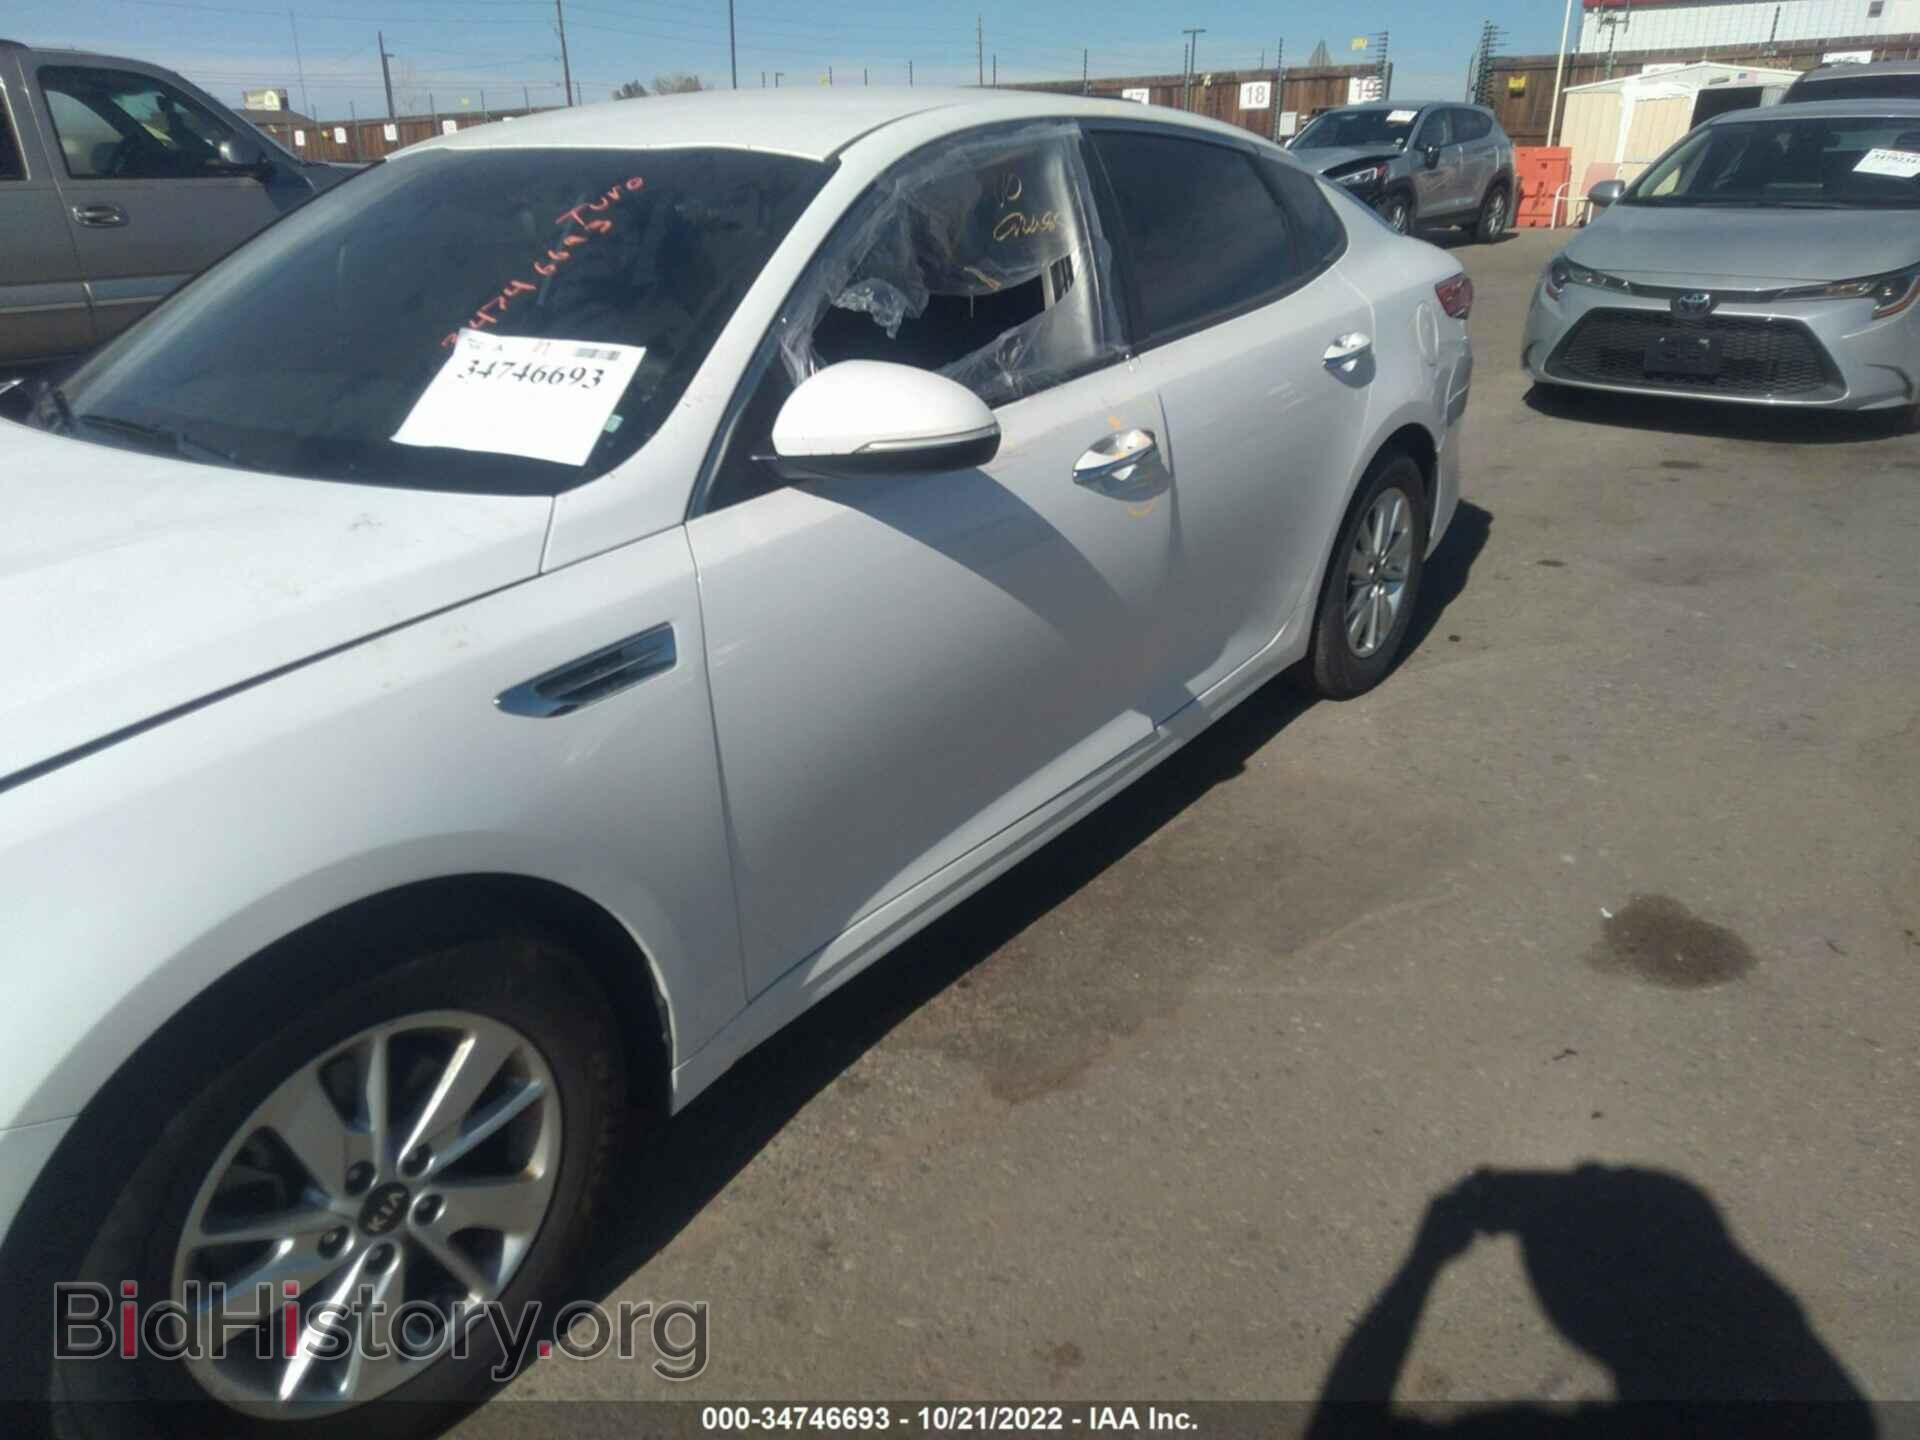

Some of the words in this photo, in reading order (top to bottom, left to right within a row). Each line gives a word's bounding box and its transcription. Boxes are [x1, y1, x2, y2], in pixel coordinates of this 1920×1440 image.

[1243, 85, 1265, 105] 18
[456, 358, 605, 389] 34746693
[366, 1191, 405, 1233] KIA
